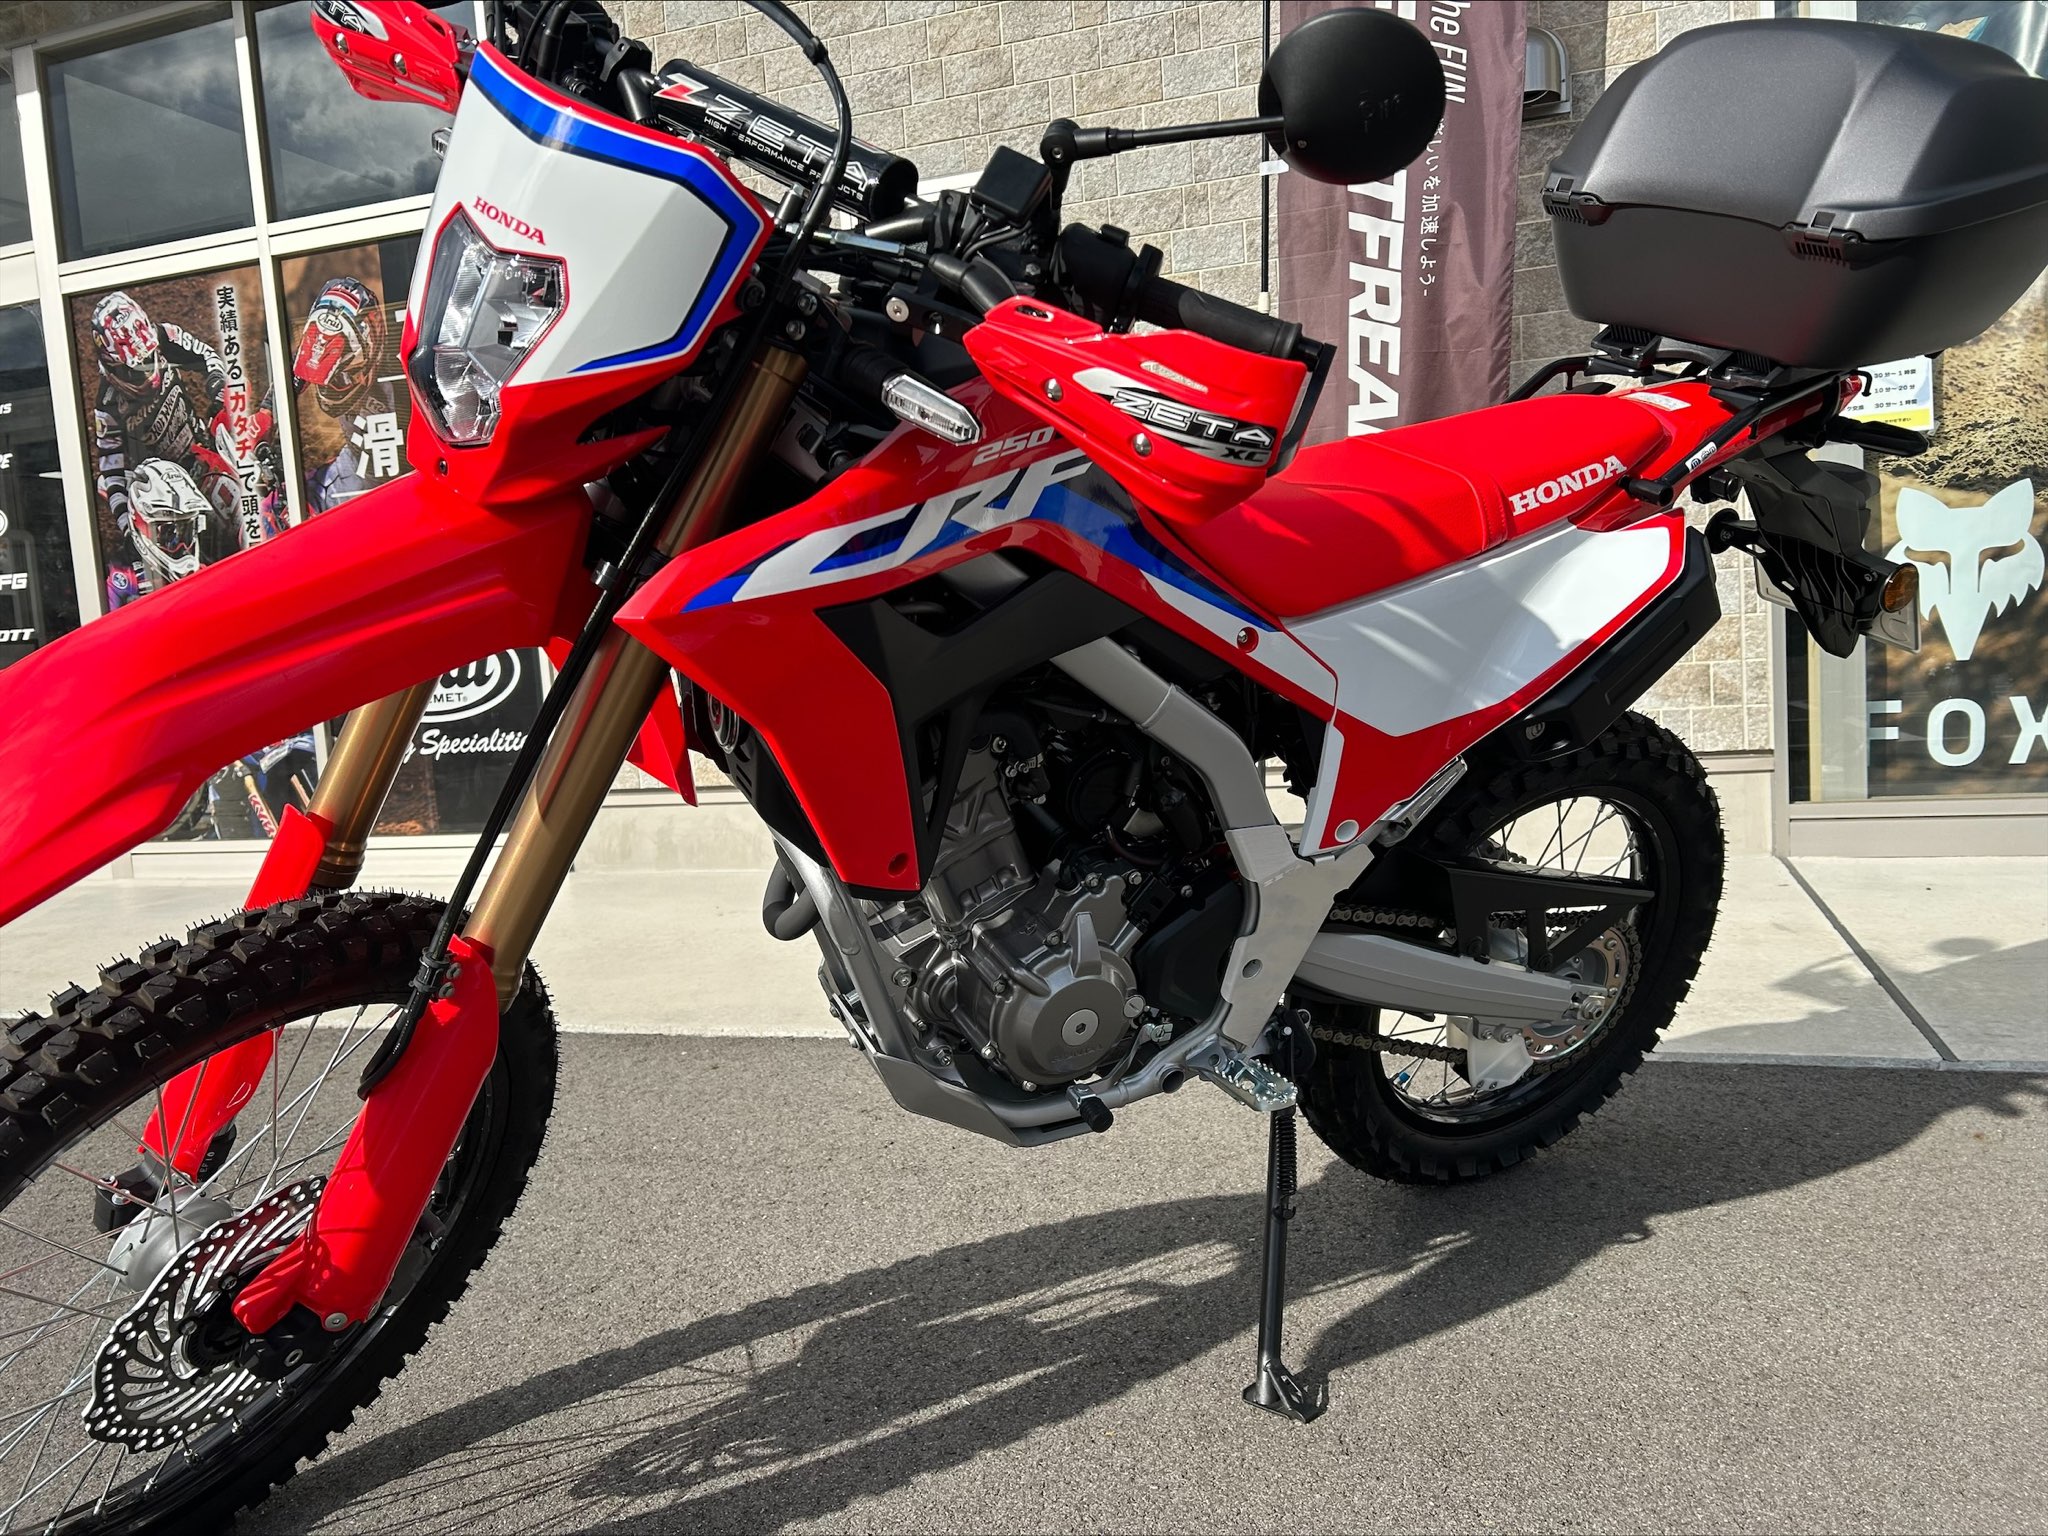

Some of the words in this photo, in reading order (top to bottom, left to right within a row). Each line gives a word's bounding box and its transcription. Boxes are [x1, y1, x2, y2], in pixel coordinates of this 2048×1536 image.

[1430, 0, 1471, 36] he
[704, 116, 727, 133] HIGH
[731, 130, 804, 172] PERFORMANCE
[705, 94, 869, 192] ZETA
[473, 196, 546, 246] HONDA
[1347, 169, 1408, 437] TFREA
[216, 285, 261, 545] 実績ある「カタチ」で頭を
[1110, 390, 1274, 449] ZETA
[972, 426, 1054, 467] 250
[1220, 446, 1269, 463] XC
[1508, 455, 1627, 516] HONDA
[1867, 696, 2048, 767] FOX
